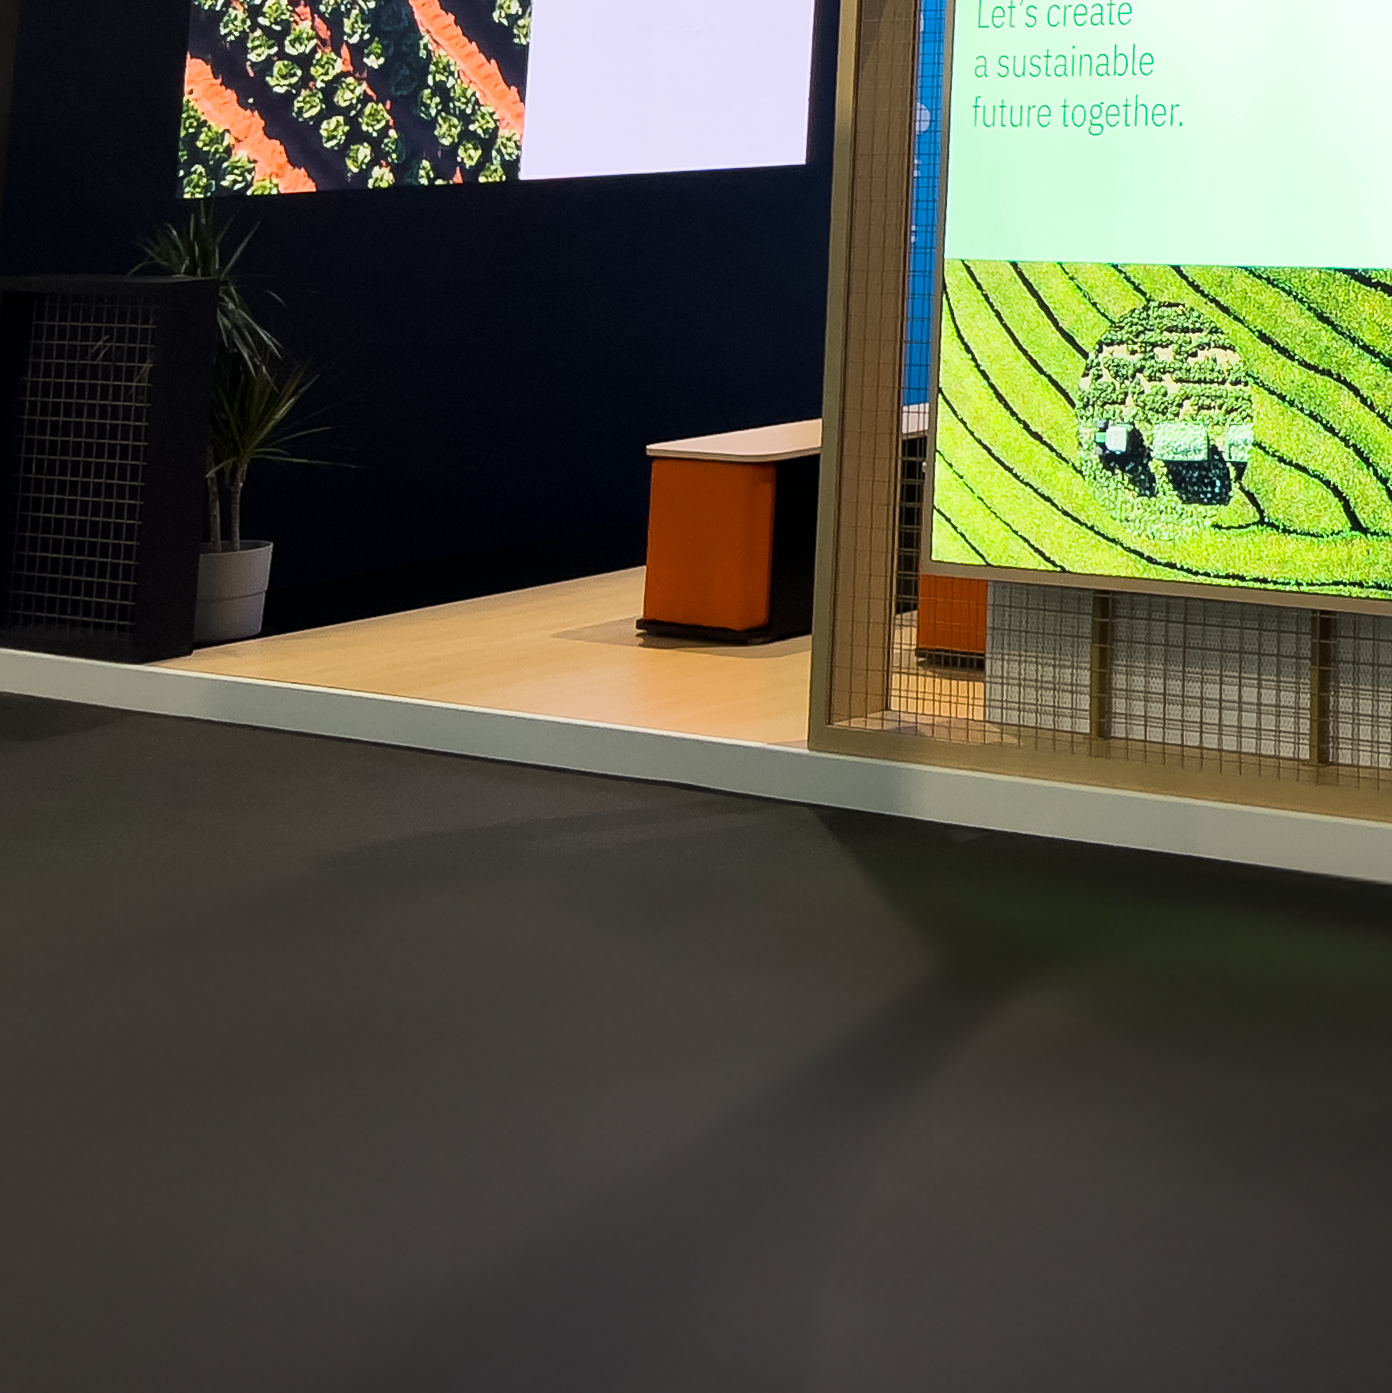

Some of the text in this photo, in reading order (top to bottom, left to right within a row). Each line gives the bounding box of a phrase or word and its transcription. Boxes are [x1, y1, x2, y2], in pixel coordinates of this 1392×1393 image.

[973, 43, 1155, 78] a sustainable
[972, 94, 1184, 136] future together.
